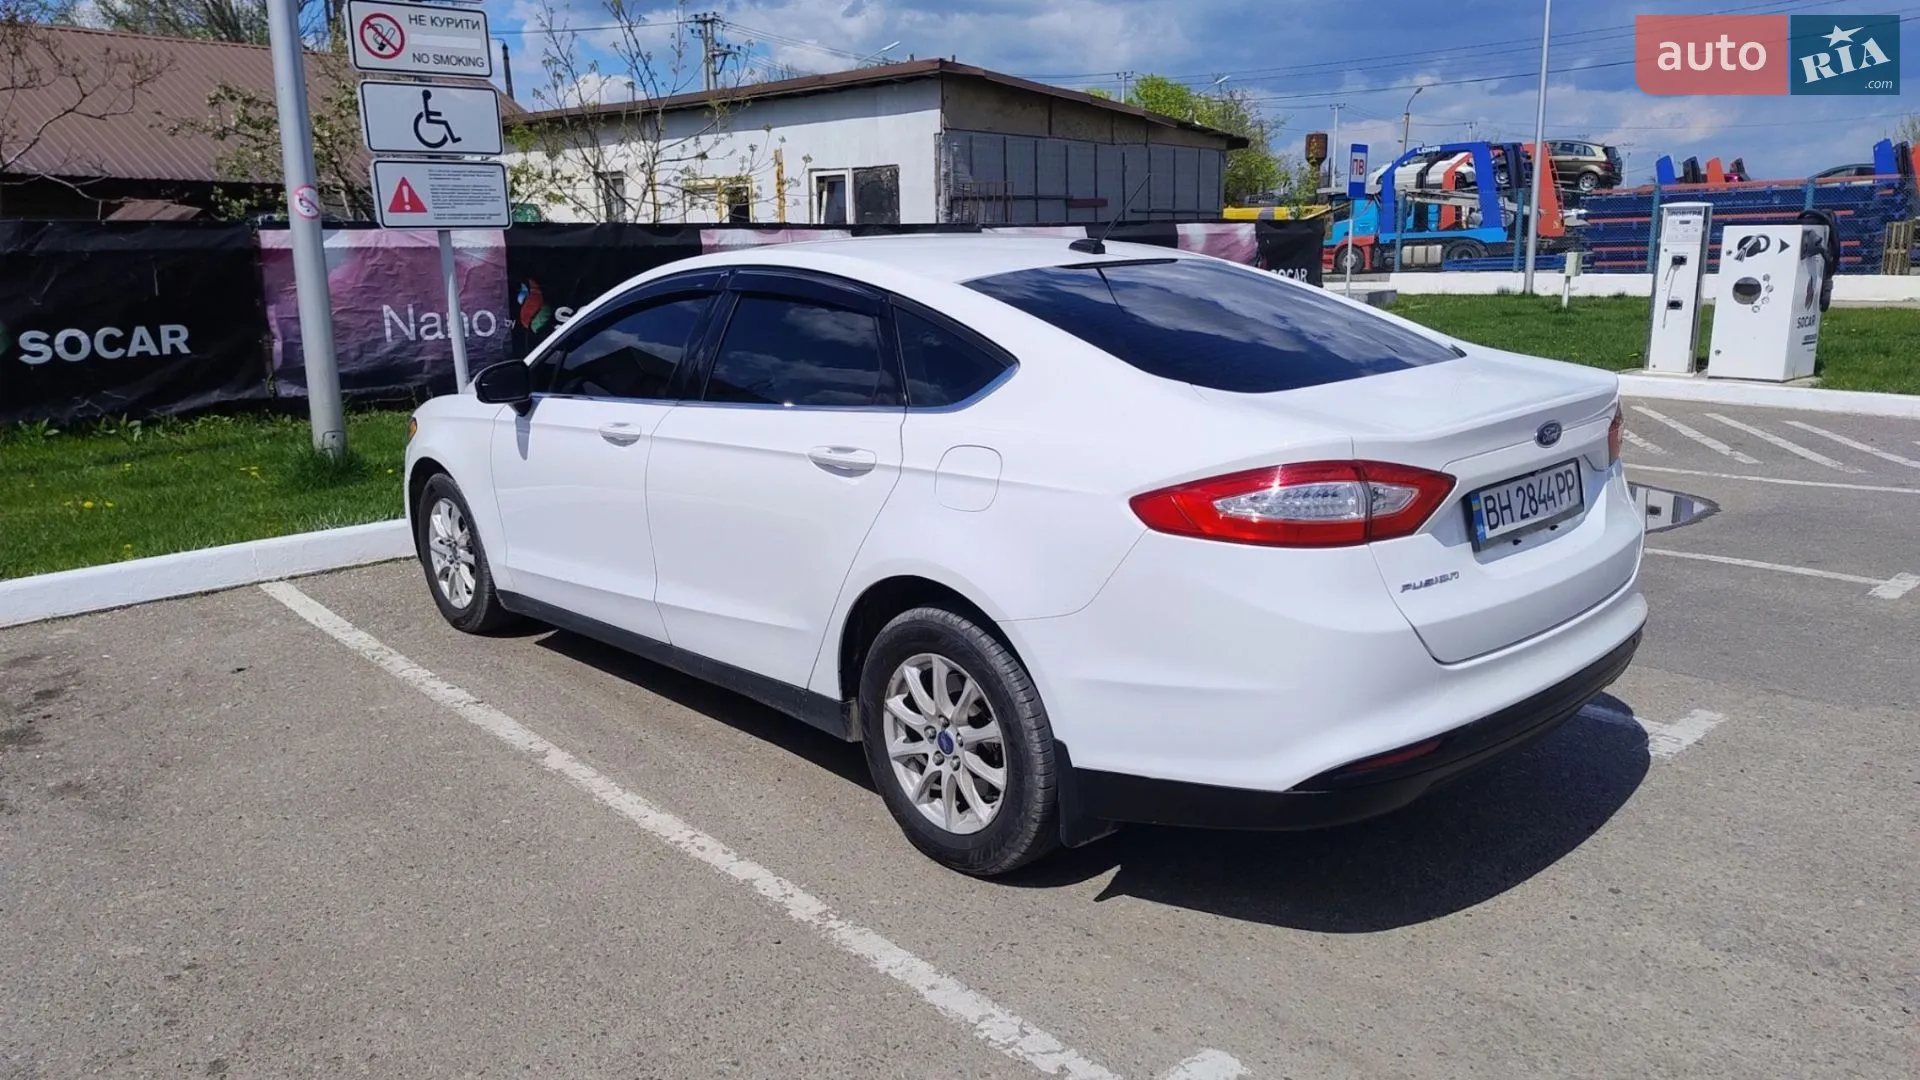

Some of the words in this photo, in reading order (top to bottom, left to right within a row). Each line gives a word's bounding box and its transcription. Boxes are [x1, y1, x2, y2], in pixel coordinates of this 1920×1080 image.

[408, 14, 427, 27] НЕ
[430, 15, 480, 30] КУРИТИ
[412, 52, 430, 65] NO
[433, 53, 484, 68] SMOKING
[1352, 158, 1365, 176] ПВ
[18, 324, 192, 365] SOCAR
[1516, 475, 1557, 520] 2844
